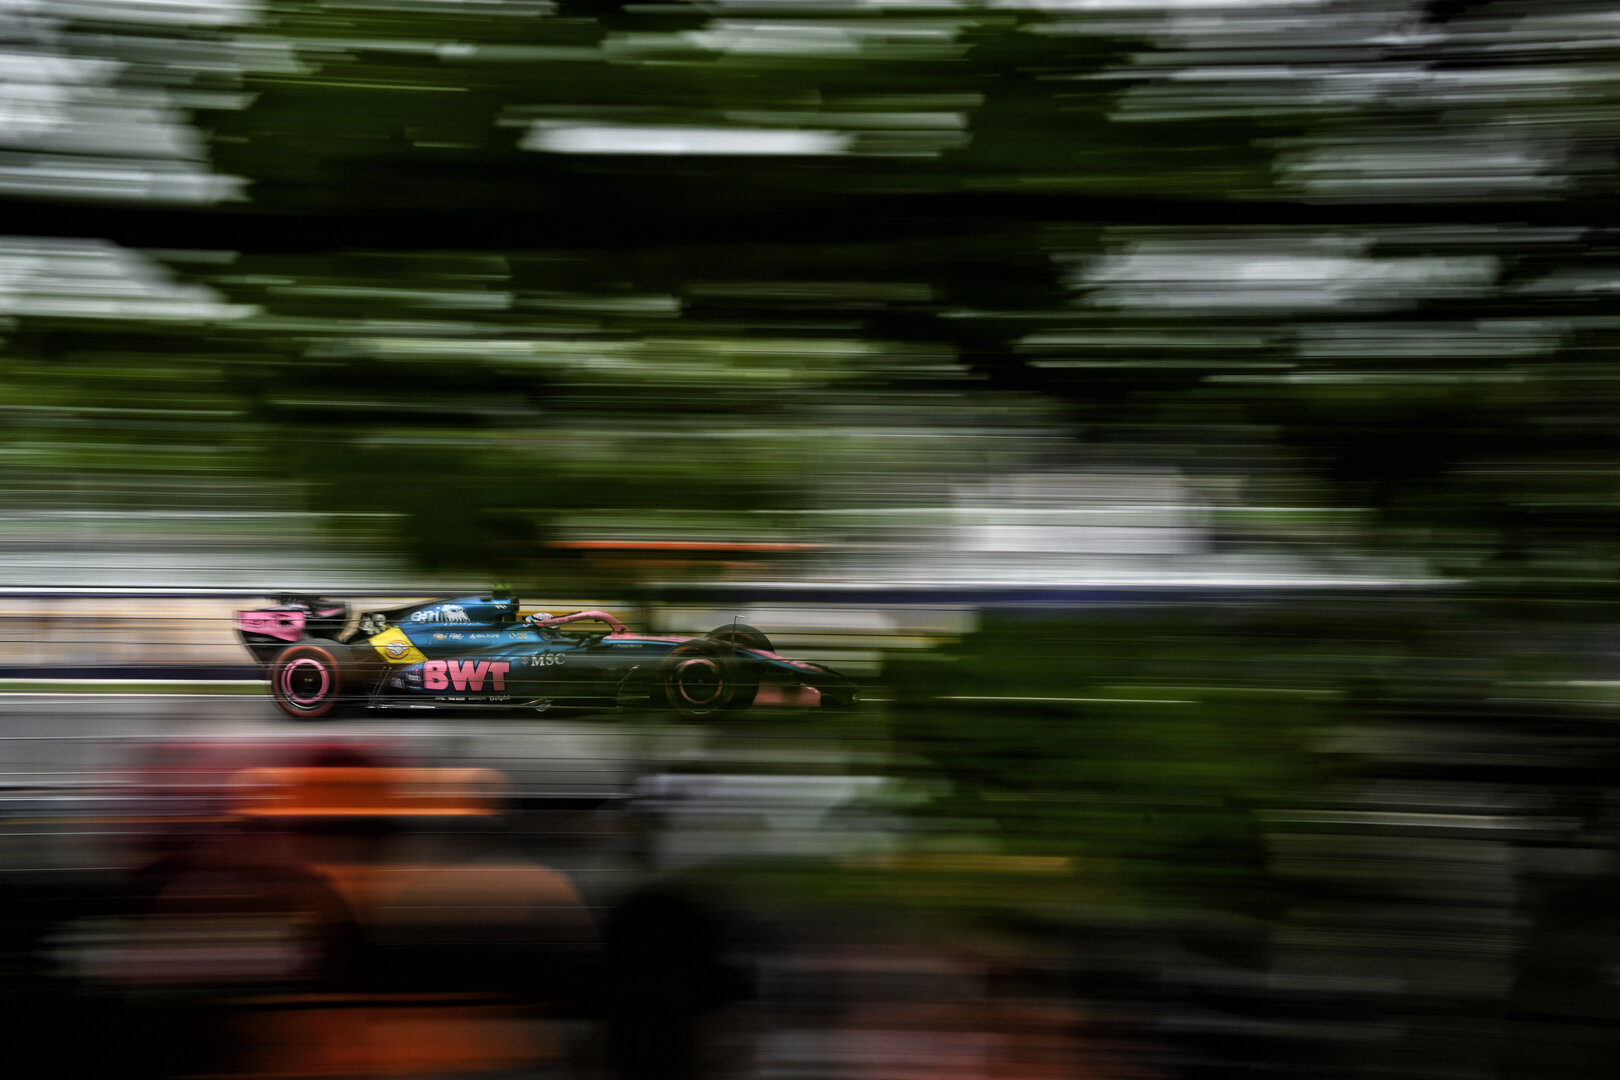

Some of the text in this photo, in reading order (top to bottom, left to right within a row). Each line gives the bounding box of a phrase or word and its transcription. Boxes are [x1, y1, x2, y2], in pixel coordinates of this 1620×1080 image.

[410, 606, 440, 622] eni
[531, 653, 566, 667] MSC
[423, 659, 510, 692] BWT
